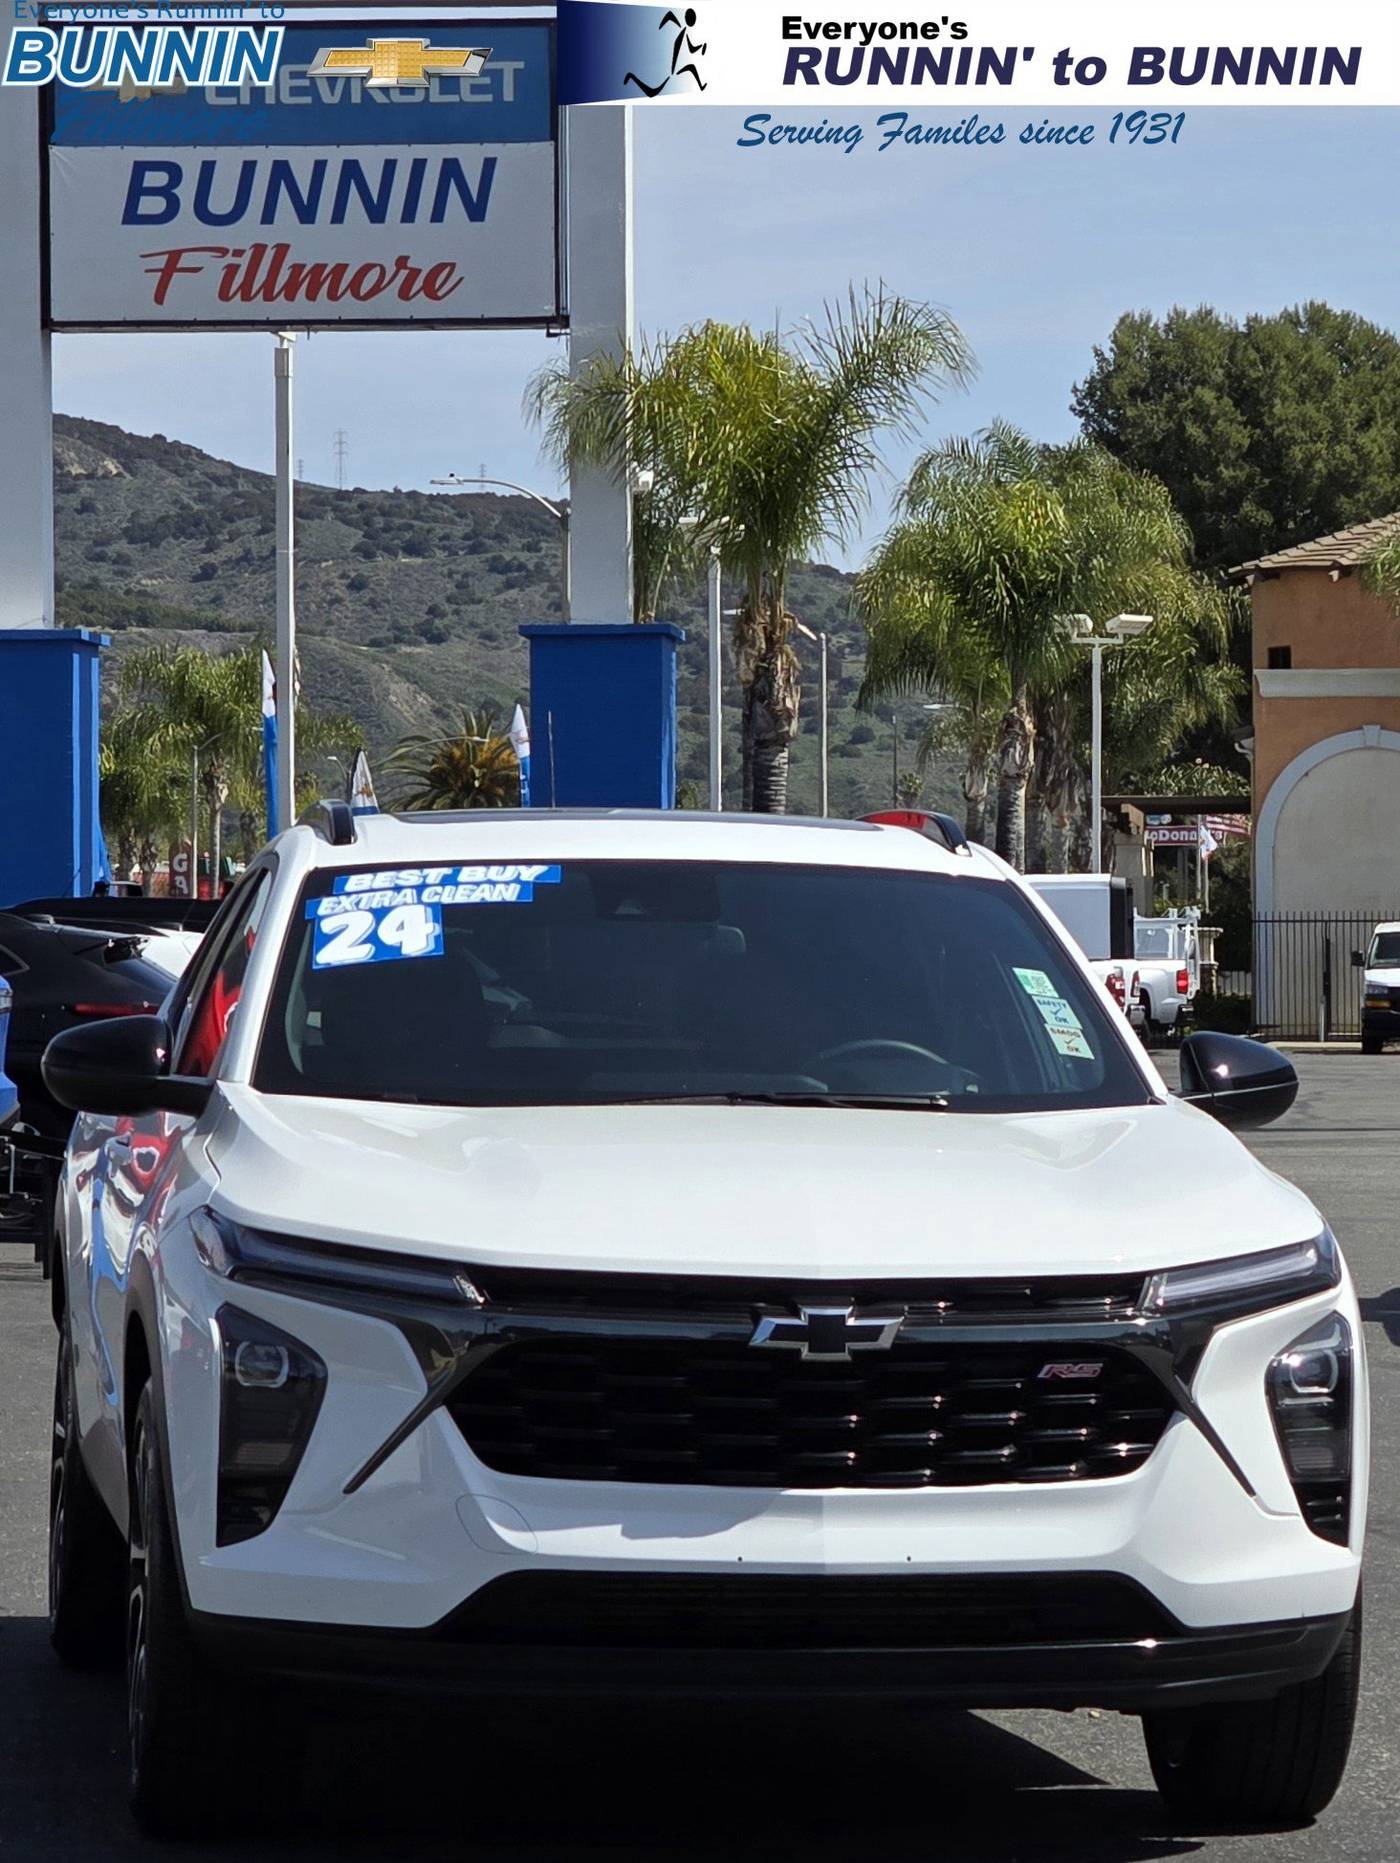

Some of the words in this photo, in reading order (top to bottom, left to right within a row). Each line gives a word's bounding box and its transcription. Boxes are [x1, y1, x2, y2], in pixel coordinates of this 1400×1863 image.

[121, 156, 498, 227] BUNNIN
[139, 242, 465, 306] Fillmore
[316, 888, 418, 916] EXTRA
[421, 883, 522, 904] CLEAN
[344, 867, 453, 892] BEST
[457, 864, 550, 883] BUY
[315, 904, 441, 966] 24
[1037, 1363, 1103, 1378] RS
